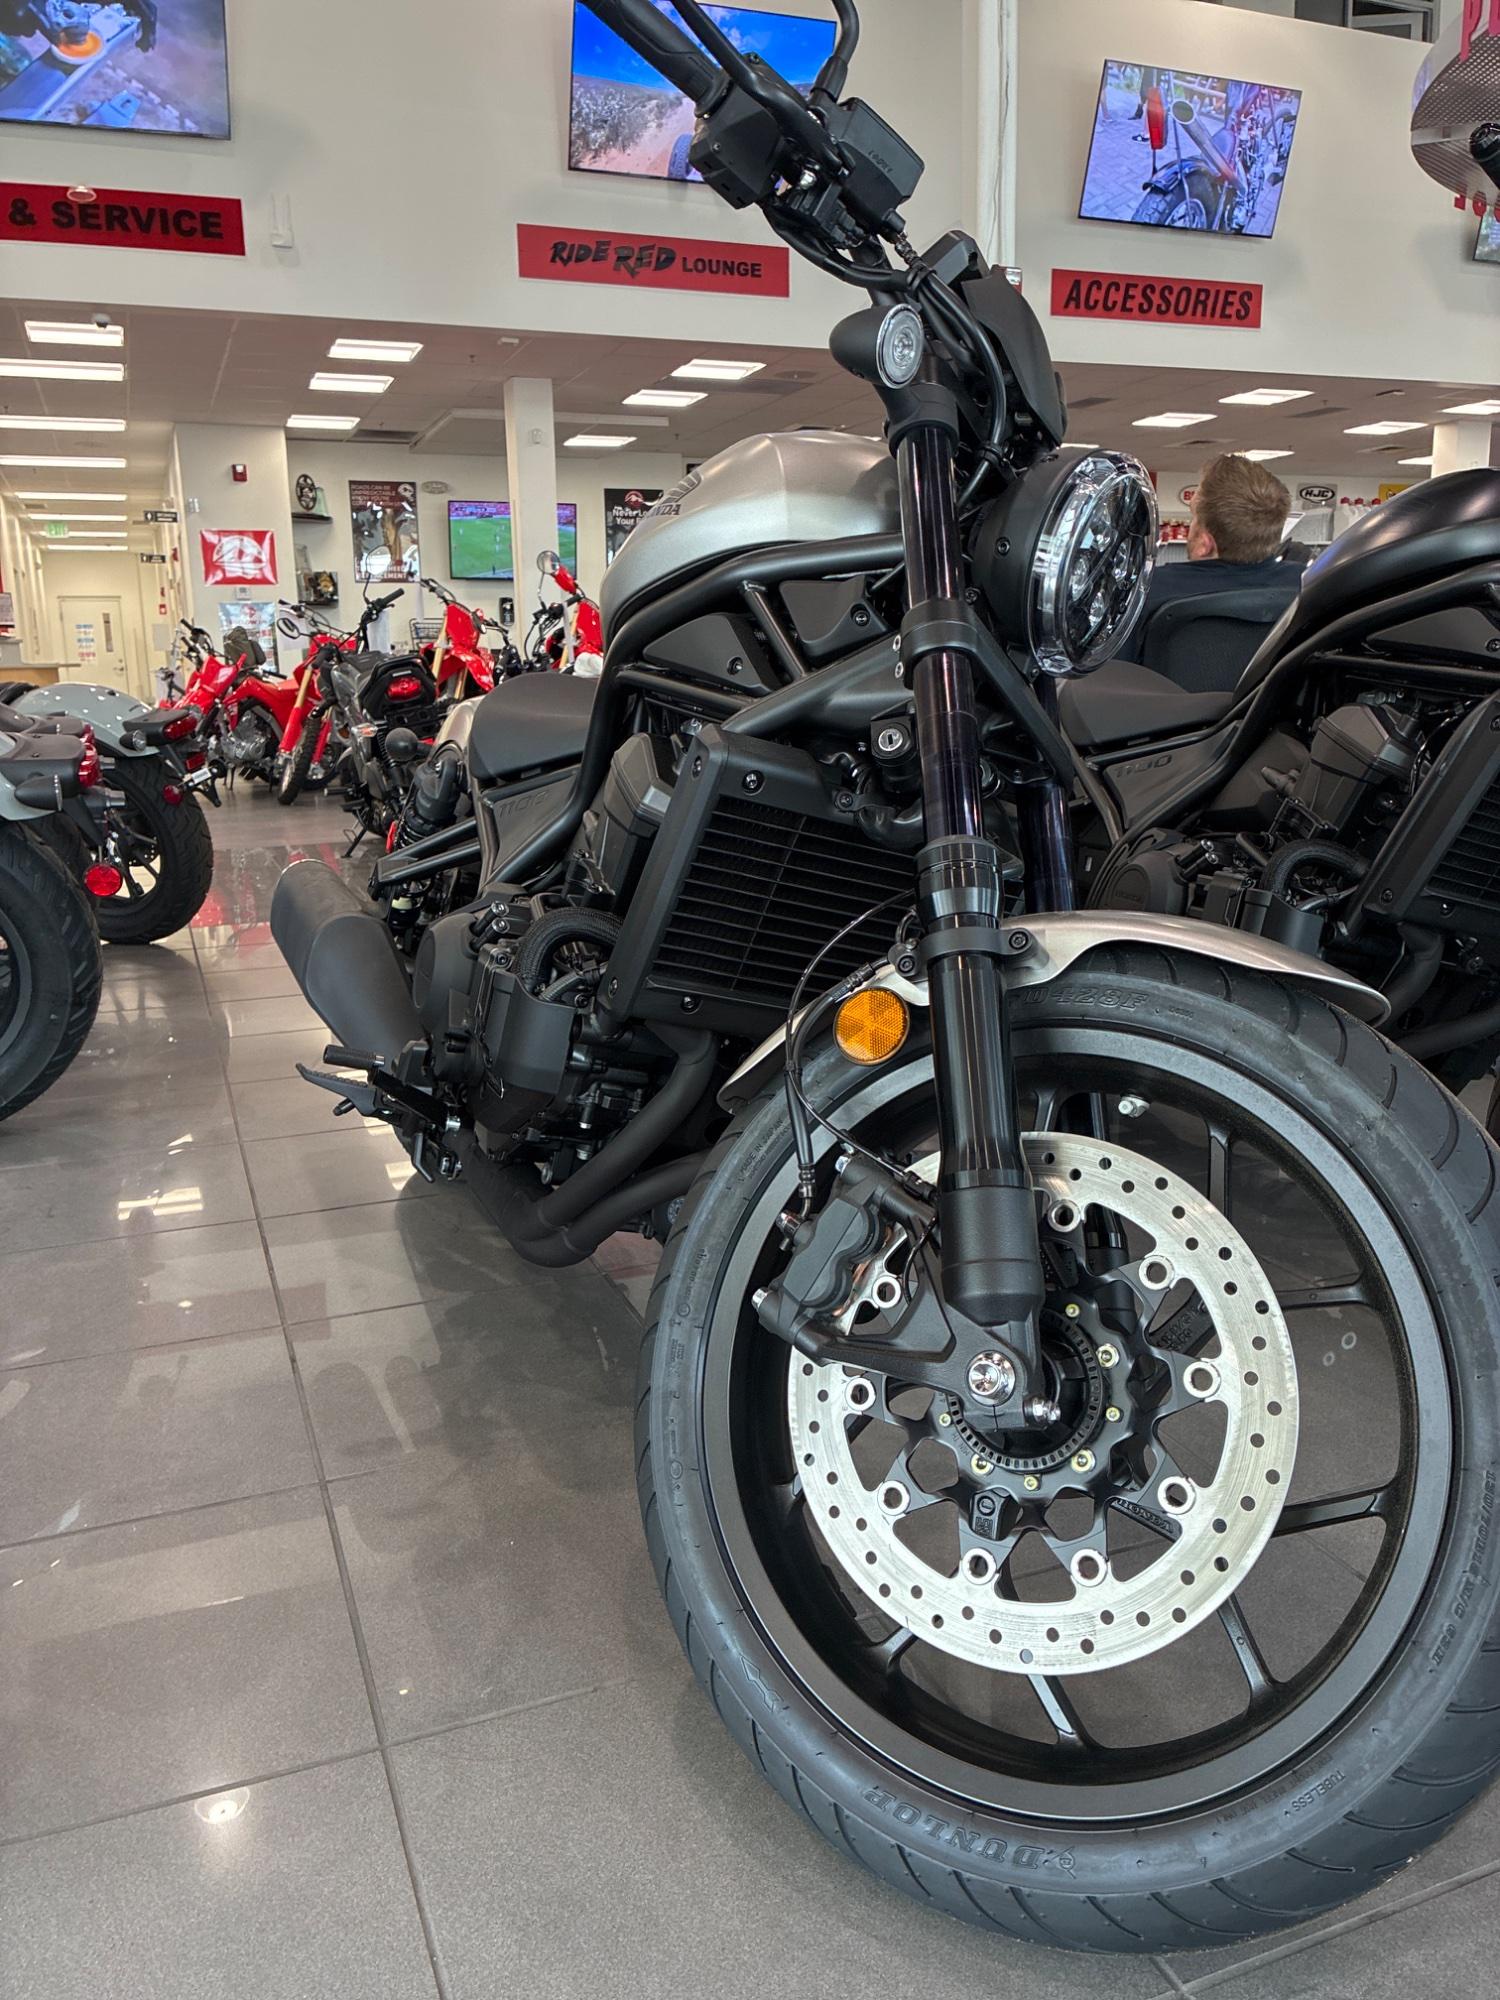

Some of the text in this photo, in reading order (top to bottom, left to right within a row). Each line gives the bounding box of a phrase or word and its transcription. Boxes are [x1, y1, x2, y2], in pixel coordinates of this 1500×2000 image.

[8, 198, 224, 240] & SERVICE
[549, 239, 762, 279] RIDE RED LOUNGE
[1063, 278, 1254, 321] ACCESSORIES
[612, 508, 639, 517] Never
[1305, 488, 1330, 498] HJC
[616, 517, 635, 525] Your
[1290, 1769, 1347, 1813] TUBELESS
[861, 1786, 1046, 1870] DUNLOP
